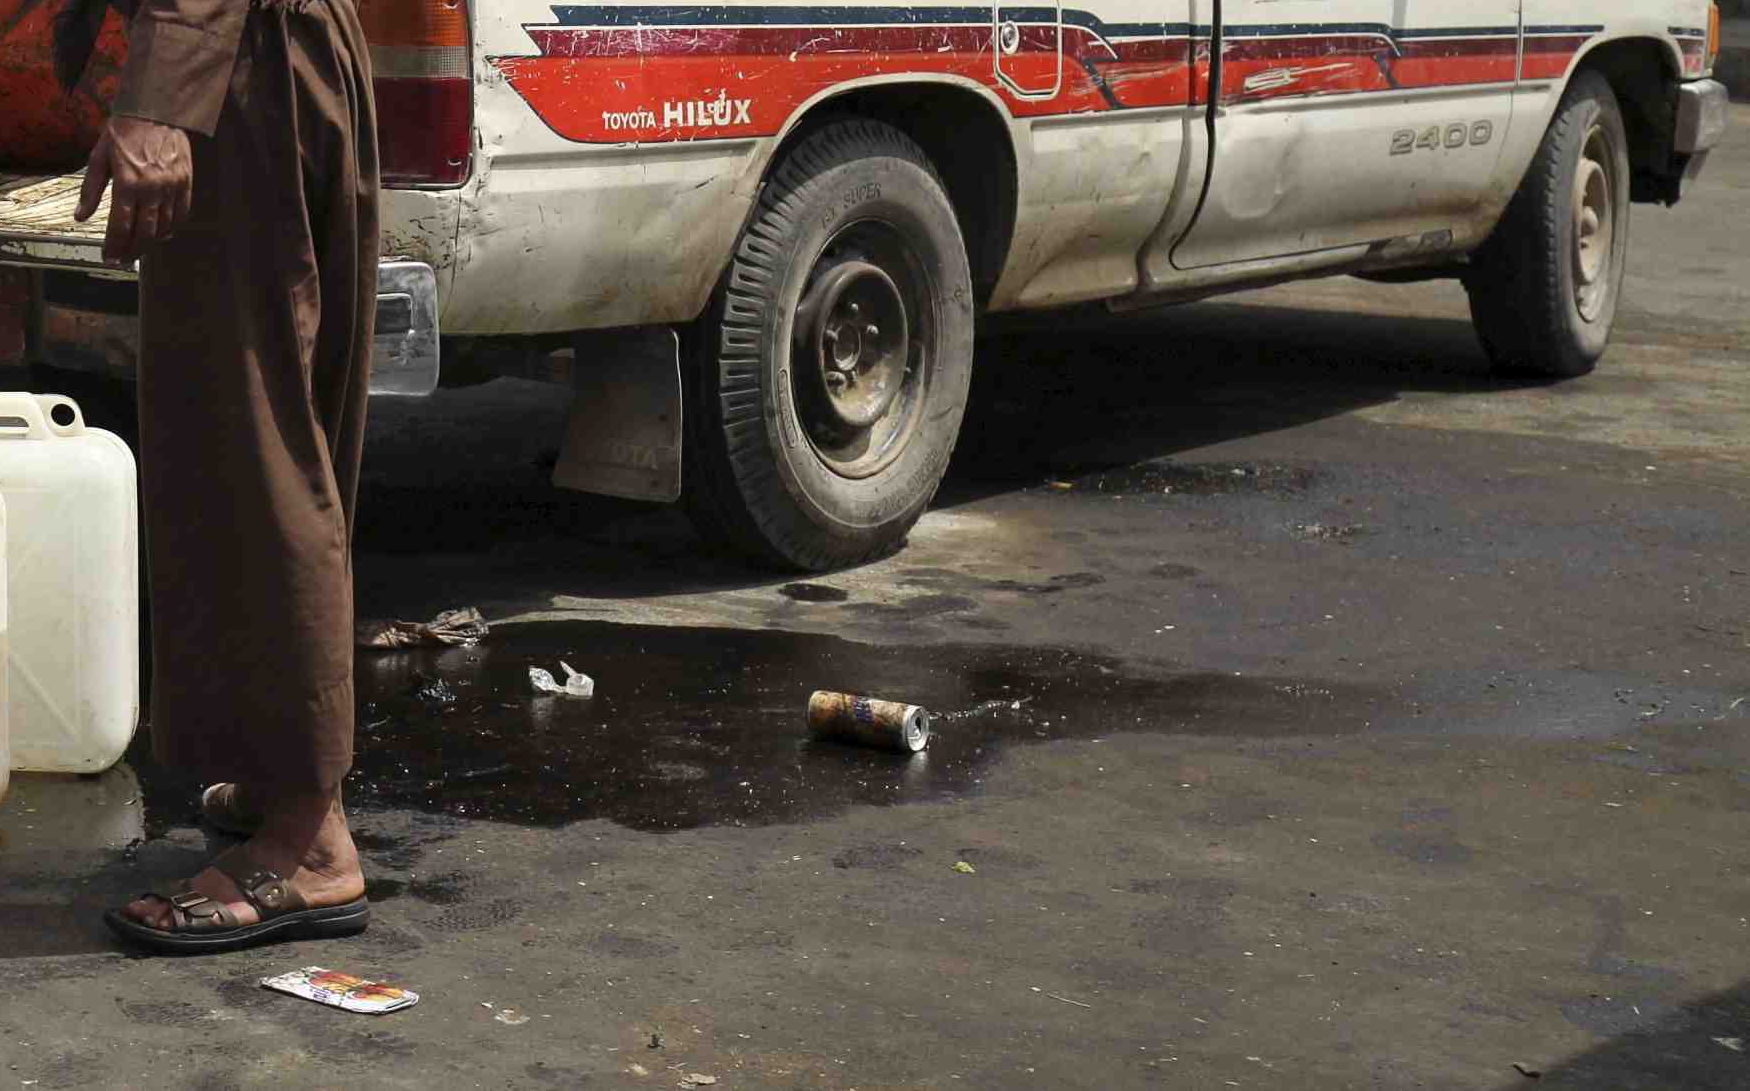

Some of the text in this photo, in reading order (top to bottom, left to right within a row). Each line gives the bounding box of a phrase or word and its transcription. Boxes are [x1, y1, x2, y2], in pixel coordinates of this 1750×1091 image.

[602, 98, 752, 130] TOYOTA HILUX
[1389, 119, 1493, 156] 2400
[843, 181, 882, 210] SUPER
